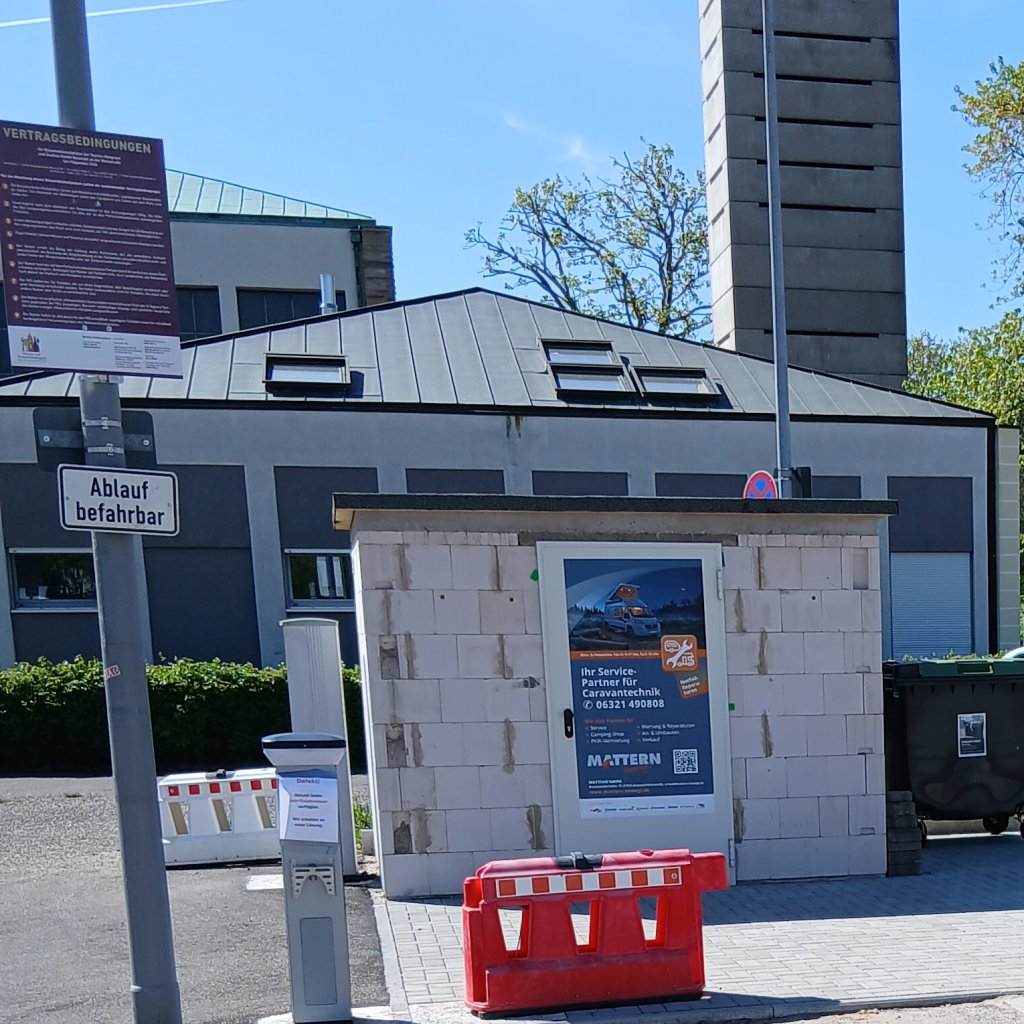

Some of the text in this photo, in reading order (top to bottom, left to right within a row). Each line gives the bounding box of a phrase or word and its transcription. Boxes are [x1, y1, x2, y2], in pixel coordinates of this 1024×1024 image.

[2, 127, 152, 154] VERTRAGSBEDINGUNGEN
[90, 477, 149, 500] Ablauf
[76, 501, 165, 526] befahrbar
[581, 666, 637, 677] Ihr Service-
[582, 677, 637, 687] Partner für
[582, 687, 661, 698] Caravantechnik
[596, 699, 665, 709] 06321 490808
[587, 752, 662, 767] MATTERN
